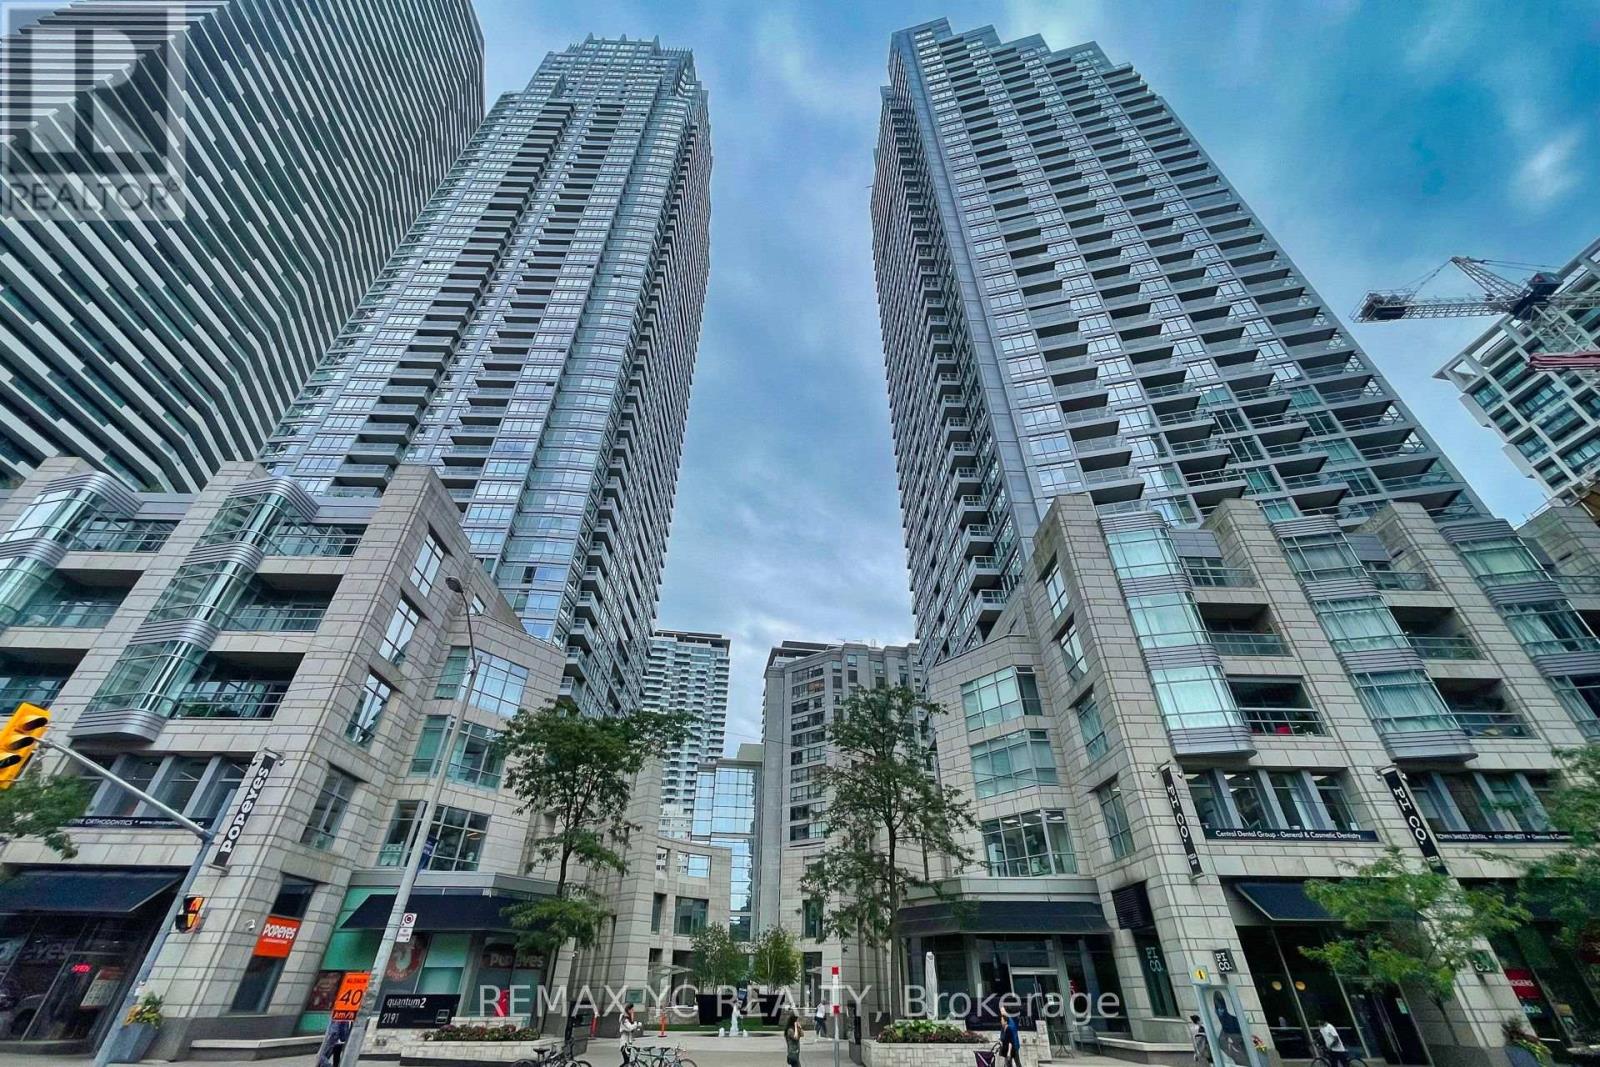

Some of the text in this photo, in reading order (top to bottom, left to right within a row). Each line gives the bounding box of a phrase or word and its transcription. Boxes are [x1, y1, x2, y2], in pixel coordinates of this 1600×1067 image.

[1167, 783, 1180, 809] PI
[1393, 786, 1413, 811] PI
[1237, 830, 1257, 838] Dental
[1257, 831, 1276, 839] Group
[1281, 831, 1303, 839] General
[1337, 832, 1361, 840] Dentistry
[262, 923, 297, 940] POPEYES
[1215, 952, 1228, 962] PI
[339, 989, 363, 1006] 40
[386, 997, 427, 1008] quantum2
[332, 1010, 355, 1020] km/h
[381, 1012, 399, 1024] 2191
